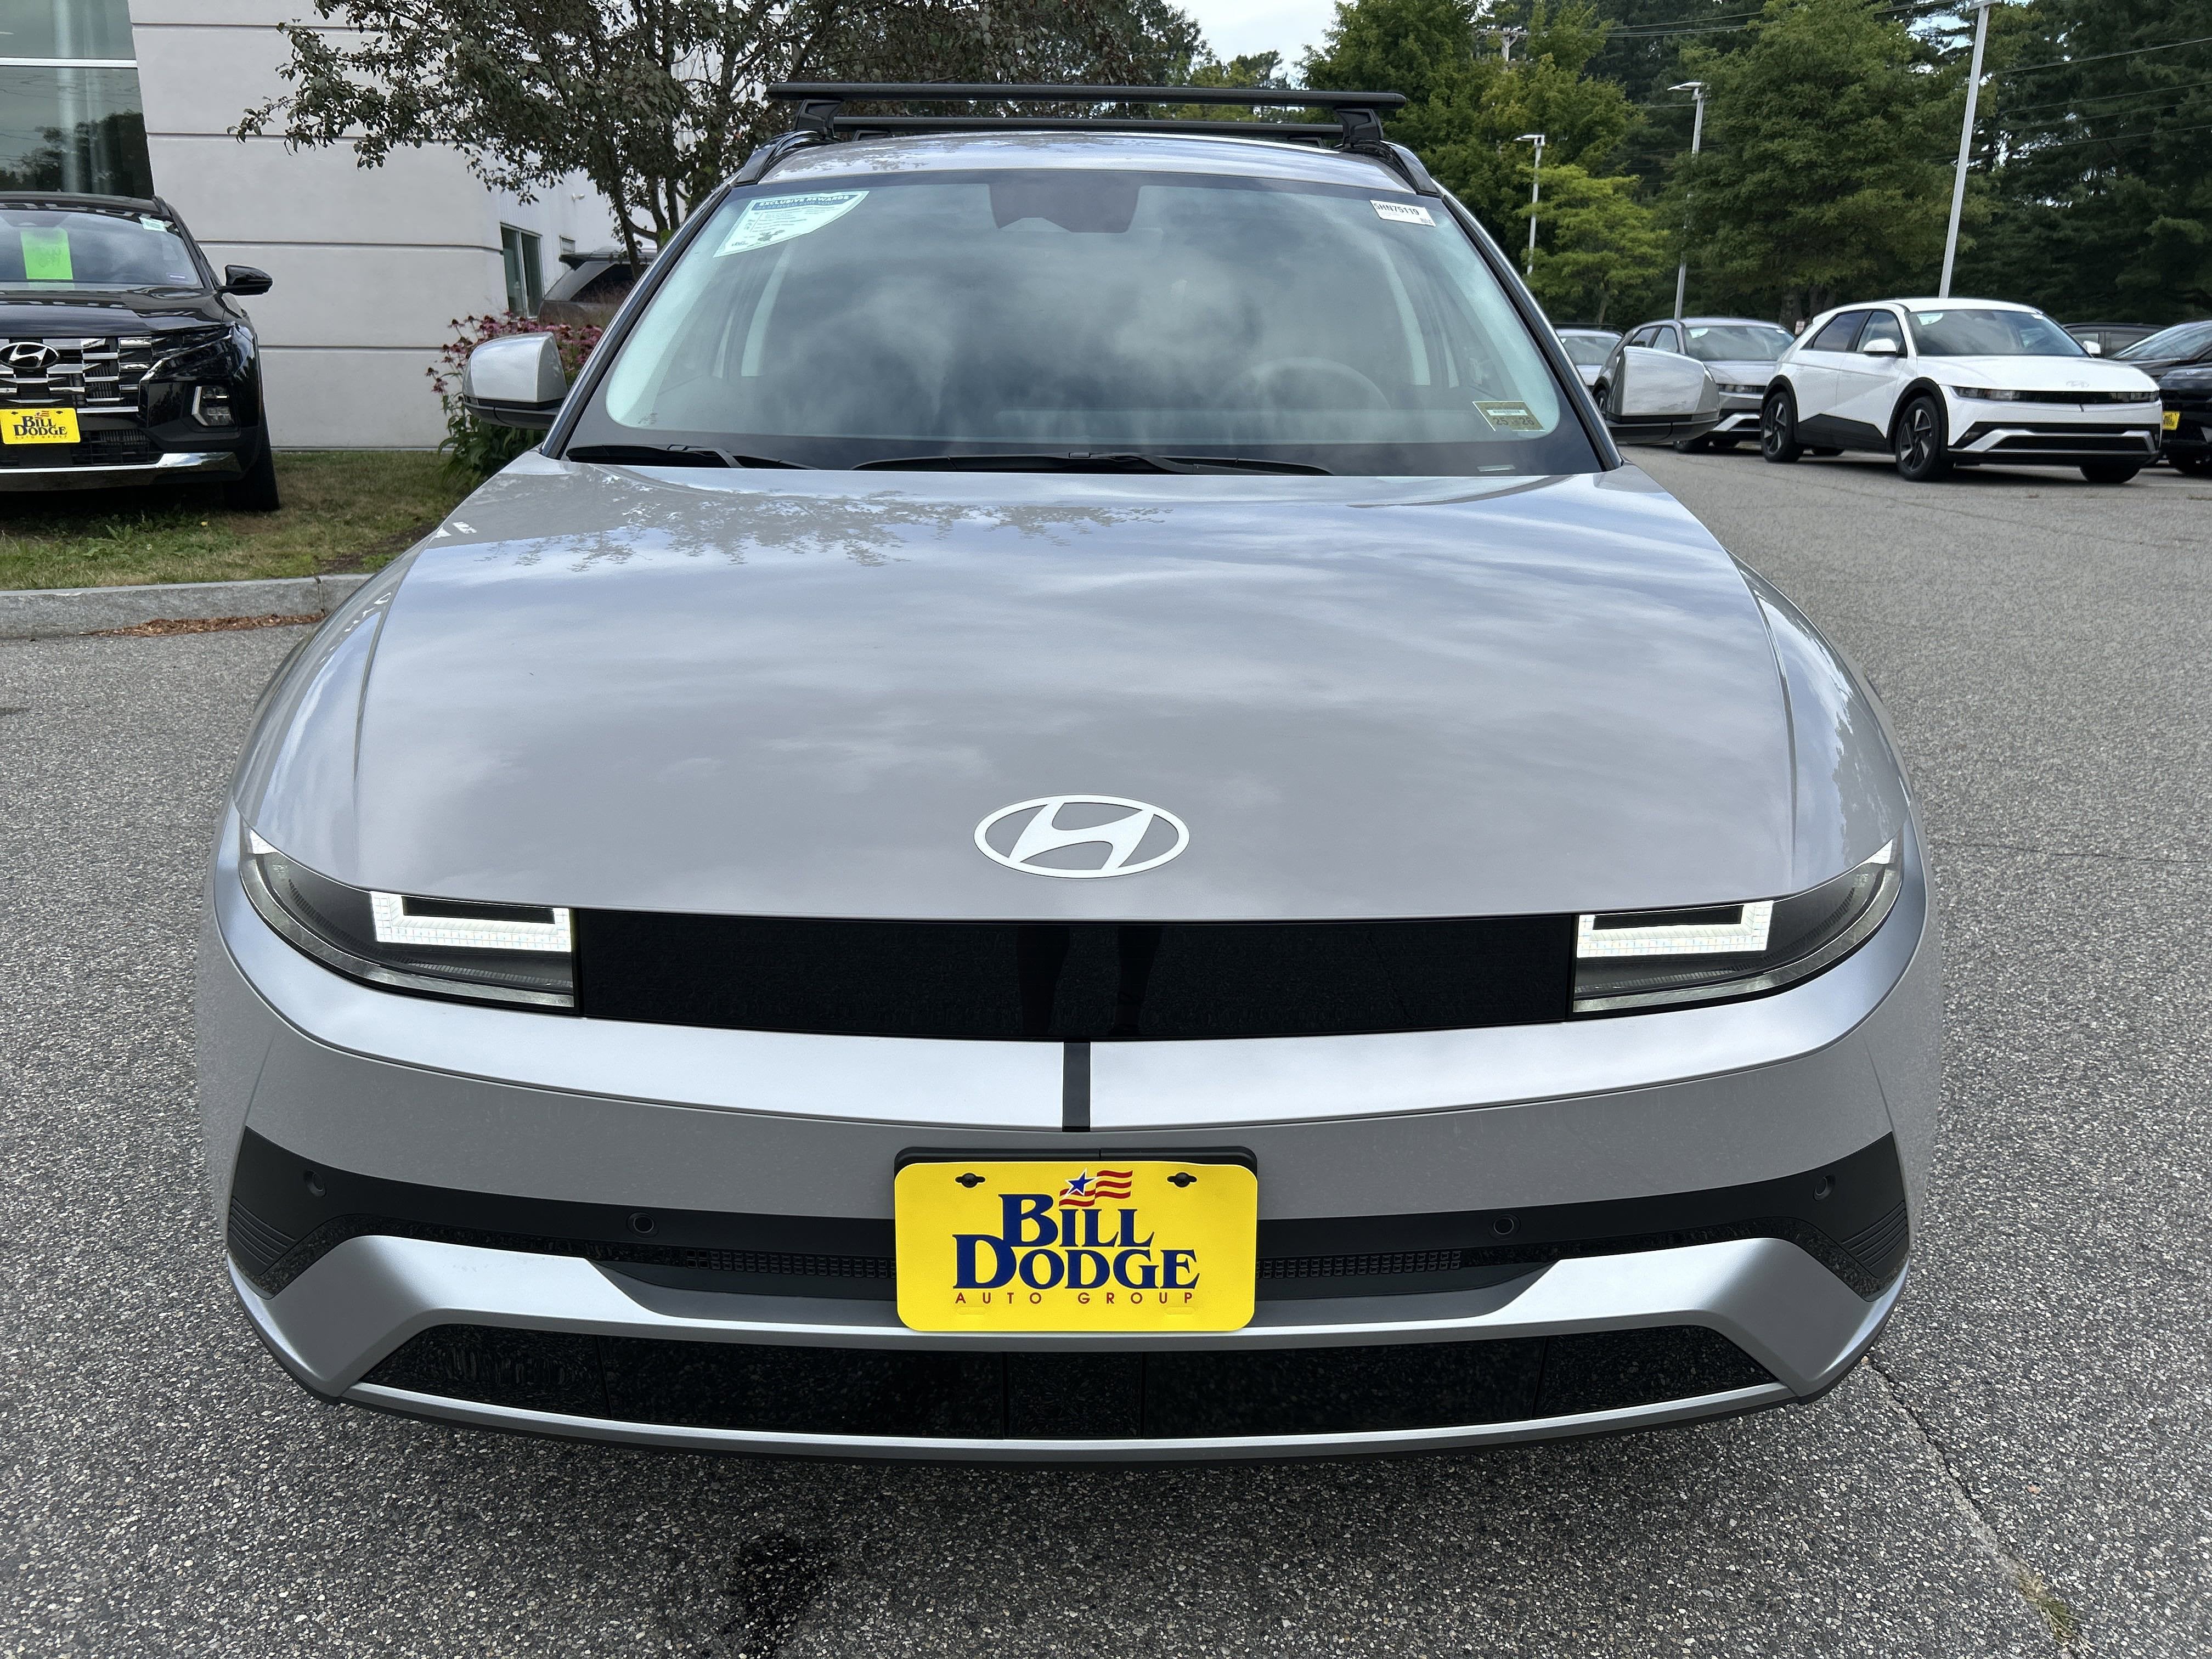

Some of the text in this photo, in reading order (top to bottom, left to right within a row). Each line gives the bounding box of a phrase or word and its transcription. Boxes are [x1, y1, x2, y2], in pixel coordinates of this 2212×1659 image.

[759, 198, 804, 206] EXCLUSIVE
[1373, 203, 1420, 216] 5HN75119
[21, 416, 57, 427] BILL
[1493, 417, 1534, 425] 25 26
[13, 425, 67, 436] DODGE
[997, 1193, 1155, 1248] BILL
[952, 1234, 1200, 1290] DODGE
[955, 1291, 1194, 1305] AUTO GROUP
